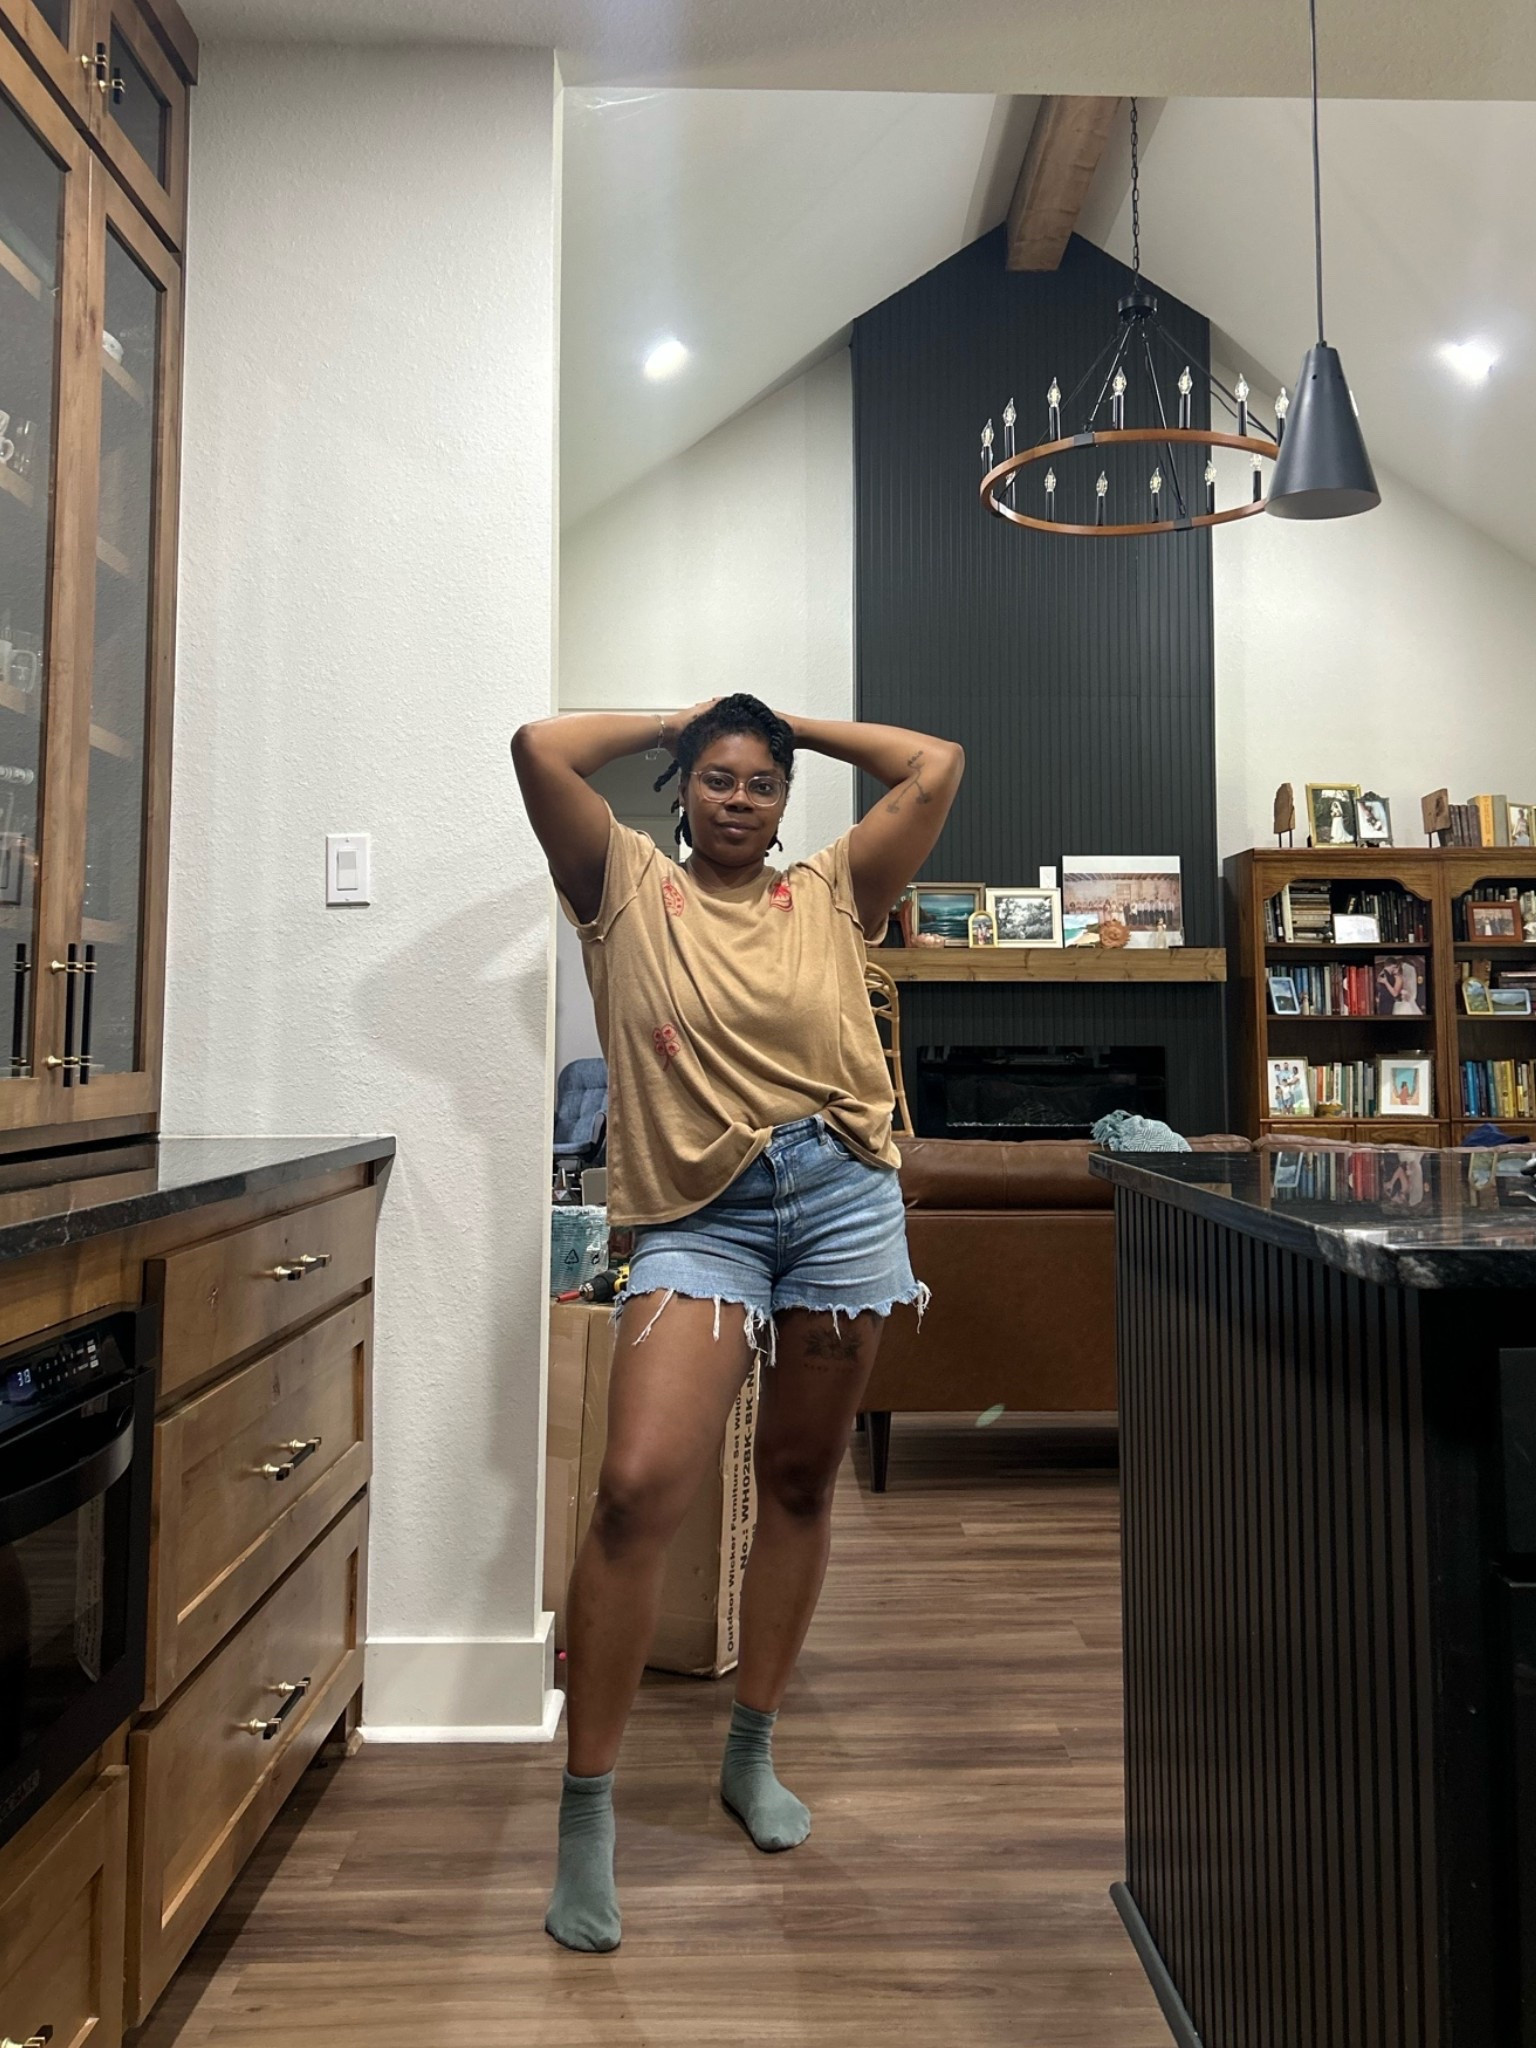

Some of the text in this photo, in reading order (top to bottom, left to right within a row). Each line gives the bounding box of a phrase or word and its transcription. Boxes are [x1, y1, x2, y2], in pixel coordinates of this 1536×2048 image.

[741, 1363, 755, 1524] WH02BK-BK-N
[730, 1463, 739, 1531] Furniture
[728, 1536, 736, 1588] Wicker
[727, 1592, 735, 1652] Outdoor
